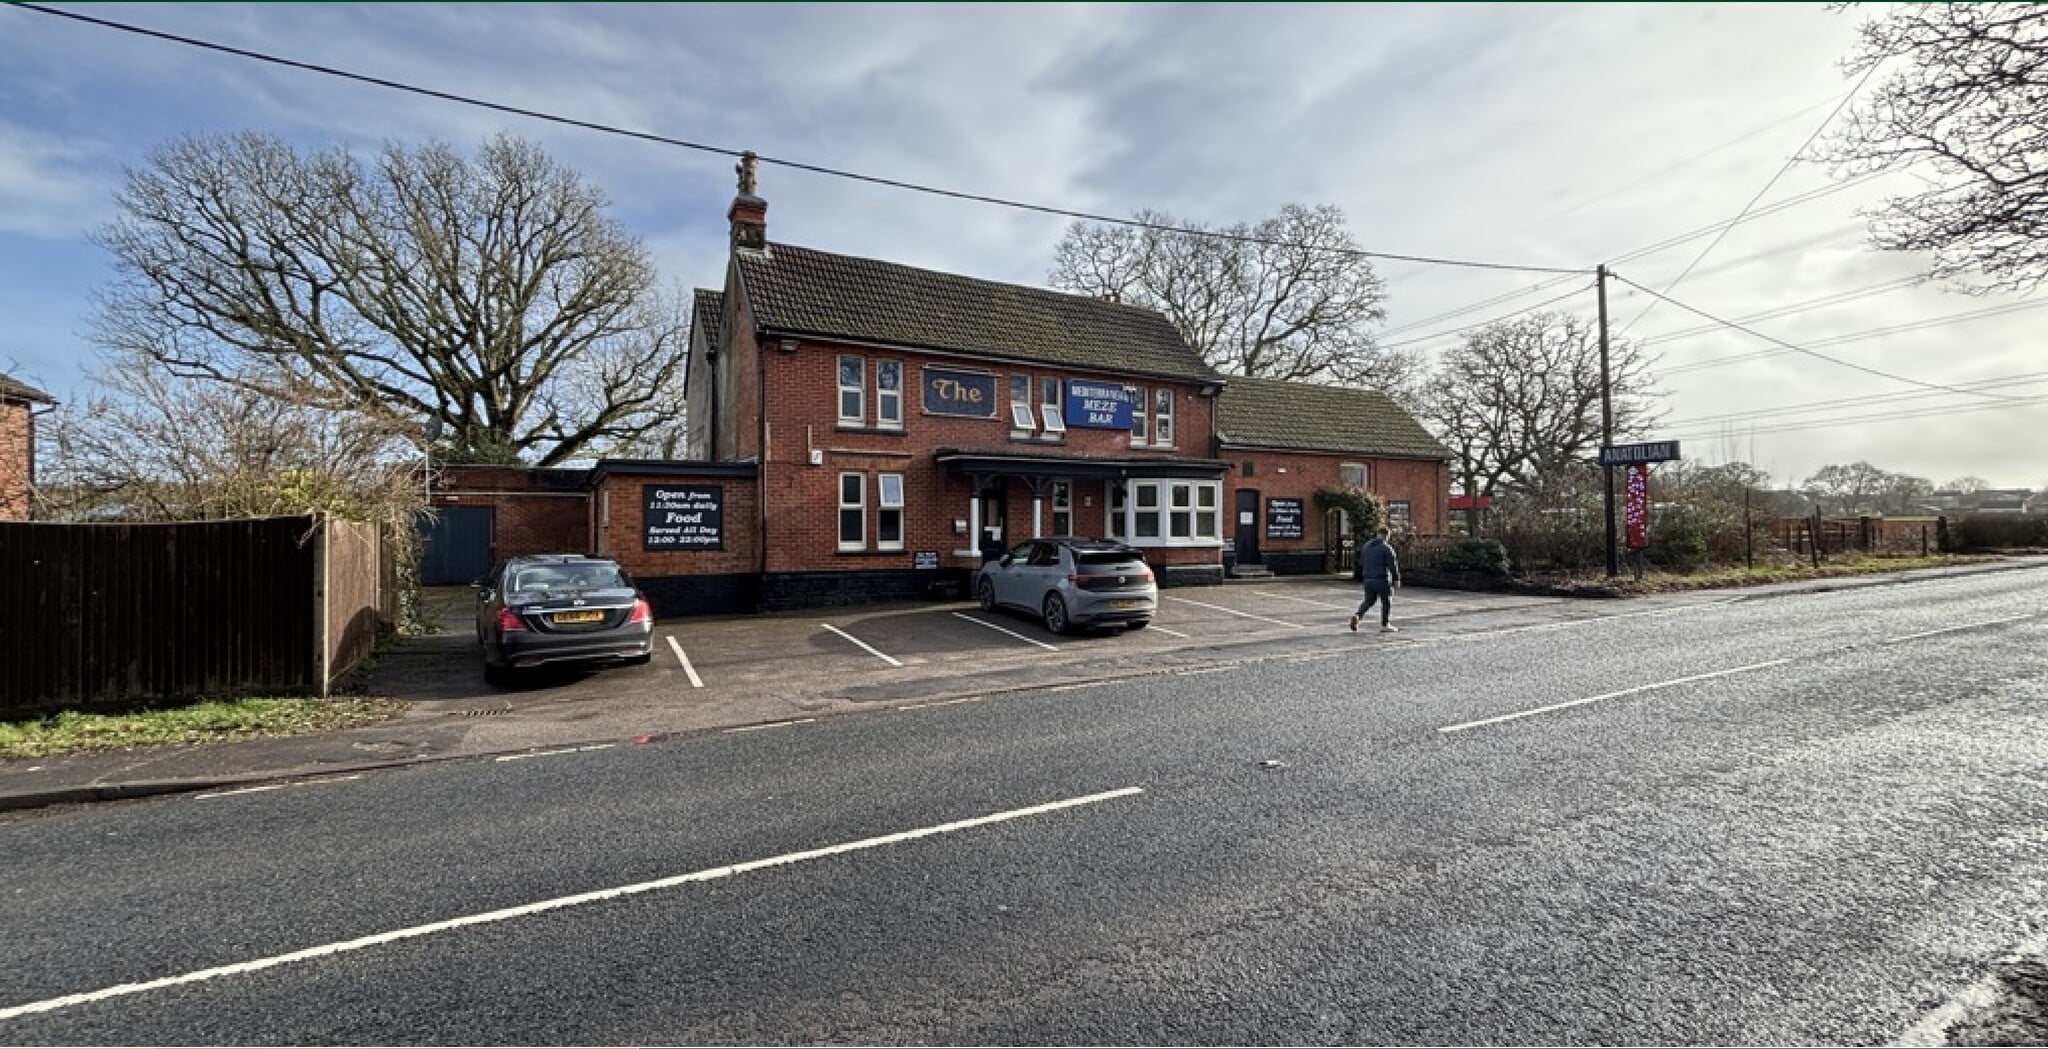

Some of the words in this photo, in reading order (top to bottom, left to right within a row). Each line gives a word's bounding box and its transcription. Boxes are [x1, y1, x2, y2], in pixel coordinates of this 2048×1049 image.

[932, 379, 983, 403] The
[1083, 399, 1117, 413] MEZE
[1088, 412, 1113, 425] BAR
[1604, 444, 1671, 462] ANATOLIAN
[656, 489, 686, 501] Open
[665, 511, 702, 523] Food
[699, 526, 718, 535] Day
